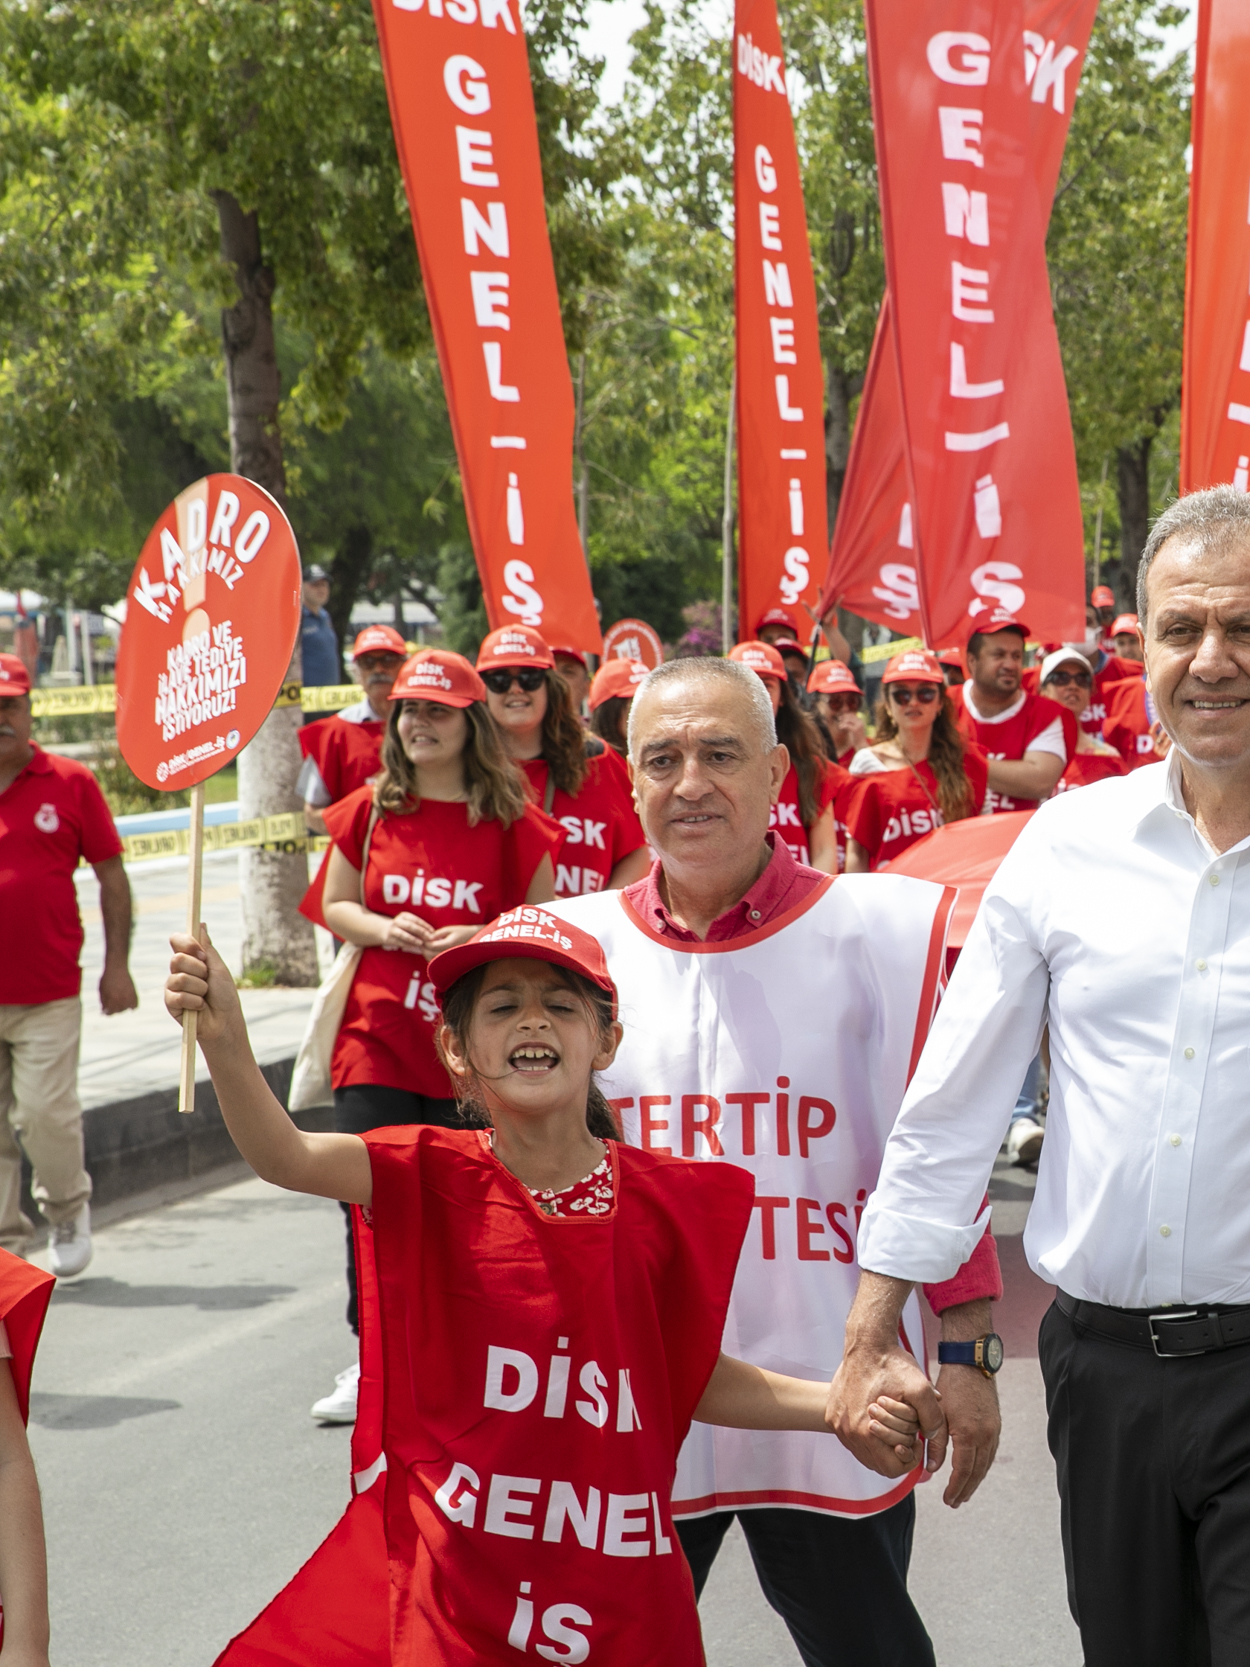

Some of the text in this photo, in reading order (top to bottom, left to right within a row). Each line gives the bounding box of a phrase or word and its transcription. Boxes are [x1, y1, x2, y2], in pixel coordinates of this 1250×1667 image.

[737, 32, 788, 96] DİSK
[133, 489, 271, 617] KADRO
[211, 620, 233, 648] VE
[155, 656, 247, 726] HAKKIMIZI
[416, 662, 445, 676] DİSK
[559, 815, 608, 851] SK
[382, 869, 484, 914] DİSK
[497, 906, 557, 929] DİSK
[752, 1188, 867, 1264] TESİ
[434, 1461, 673, 1558] GENEL
